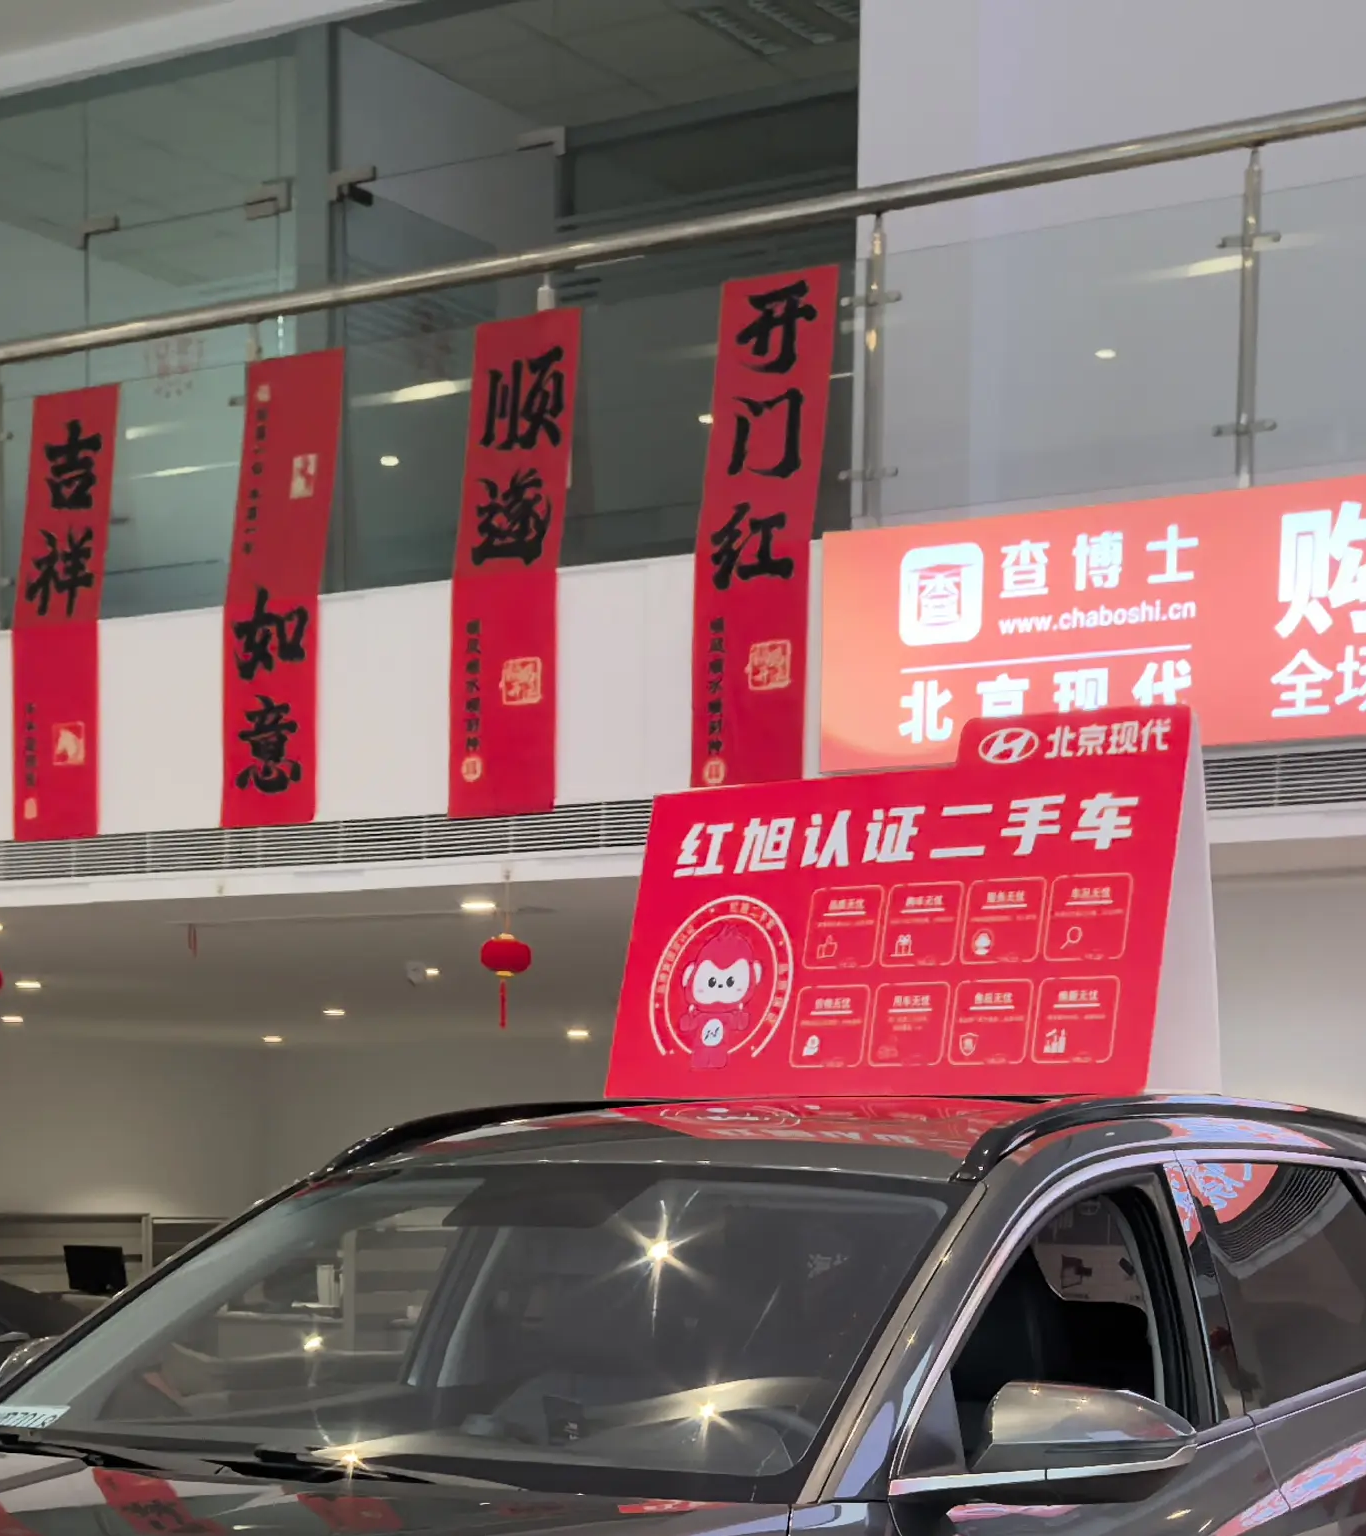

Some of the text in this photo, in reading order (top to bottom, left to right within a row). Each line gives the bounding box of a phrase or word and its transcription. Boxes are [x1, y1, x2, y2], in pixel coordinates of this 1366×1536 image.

[709, 280, 818, 591] 开门红
[26, 420, 101, 618] 吉祥
[997, 523, 1199, 598] 查博士
[999, 598, 1197, 636] www.chaboshi.cn
[233, 585, 308, 794] 如意
[898, 659, 1192, 744] 北京现代
[1044, 718, 1172, 759] 北京现代
[673, 793, 1140, 878] 红旭认证二手车
